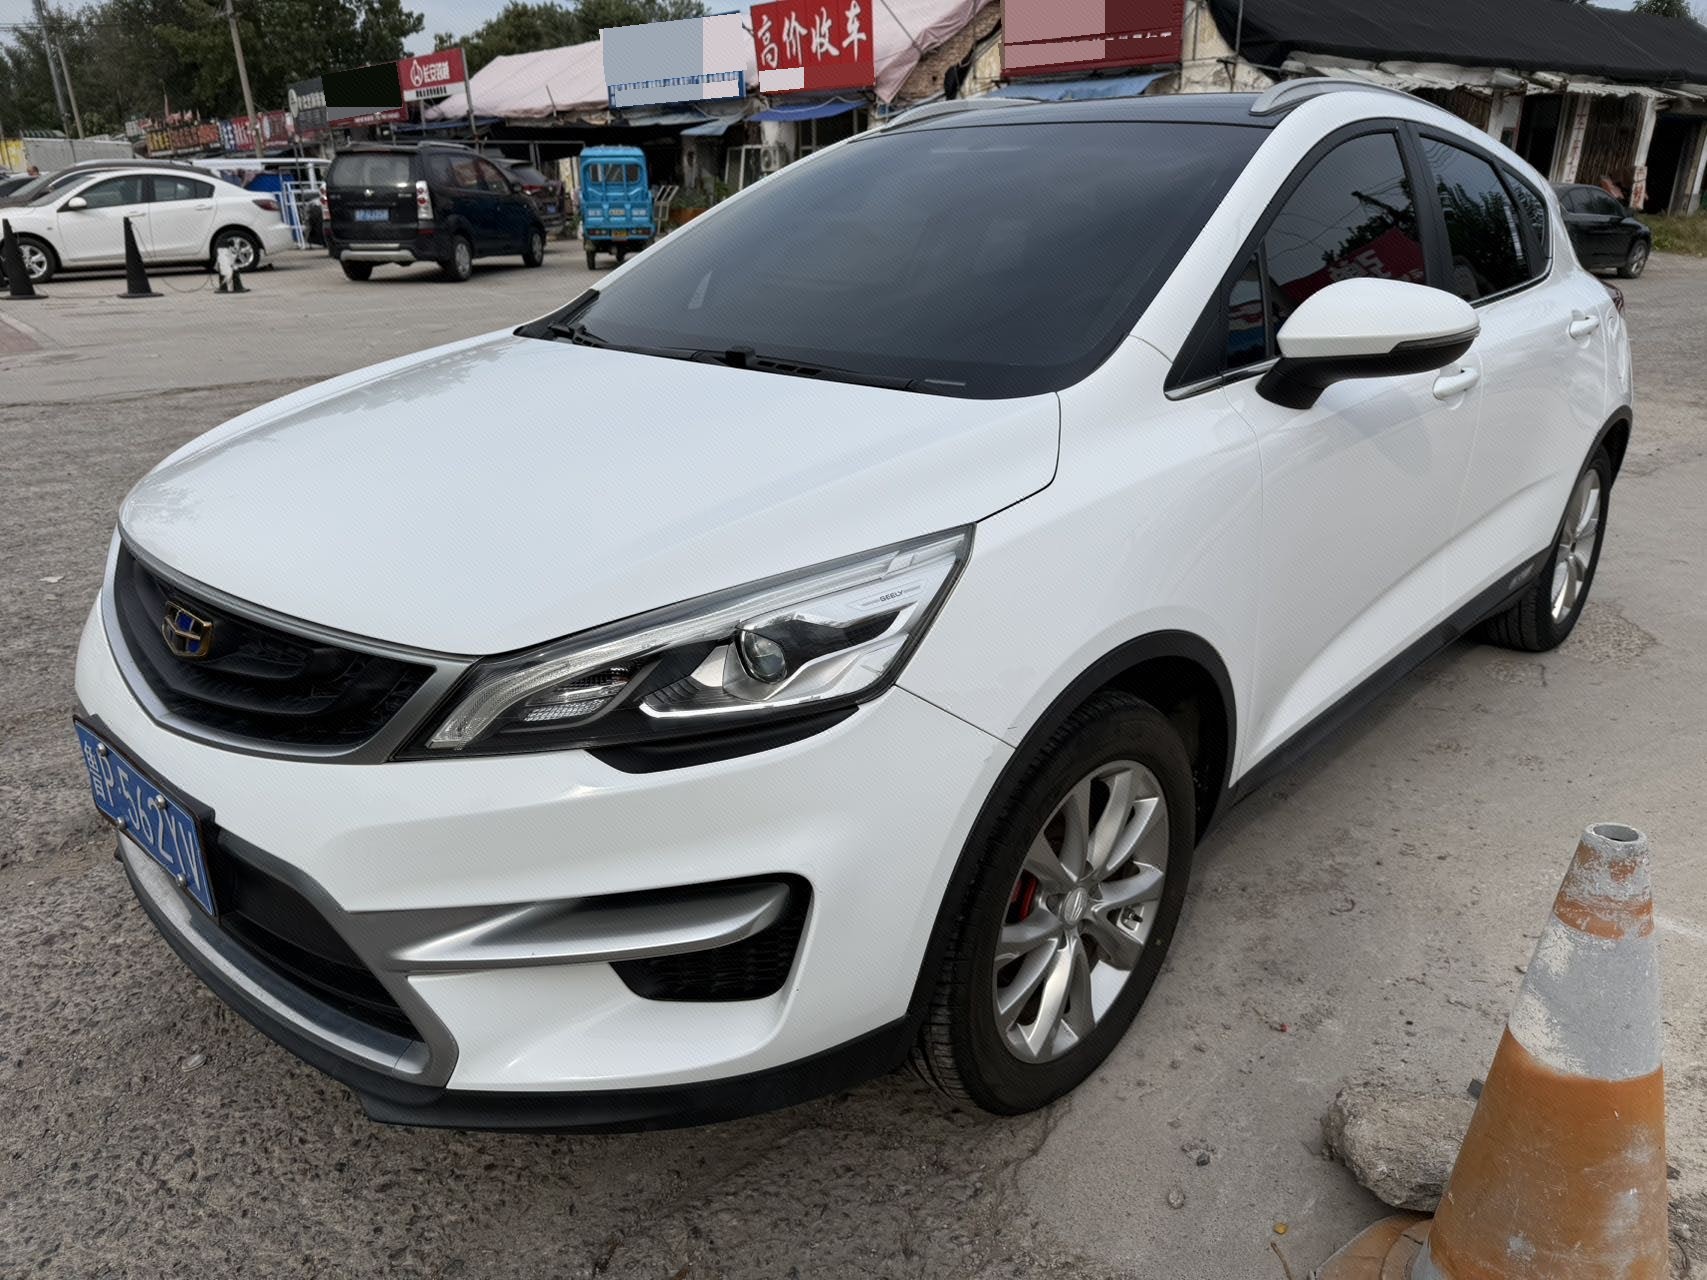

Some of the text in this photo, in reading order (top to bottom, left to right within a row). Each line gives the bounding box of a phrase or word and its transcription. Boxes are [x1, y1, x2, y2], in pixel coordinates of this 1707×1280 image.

[757, 0, 867, 69] 高价收车
[879, 589, 903, 602] GEELY
